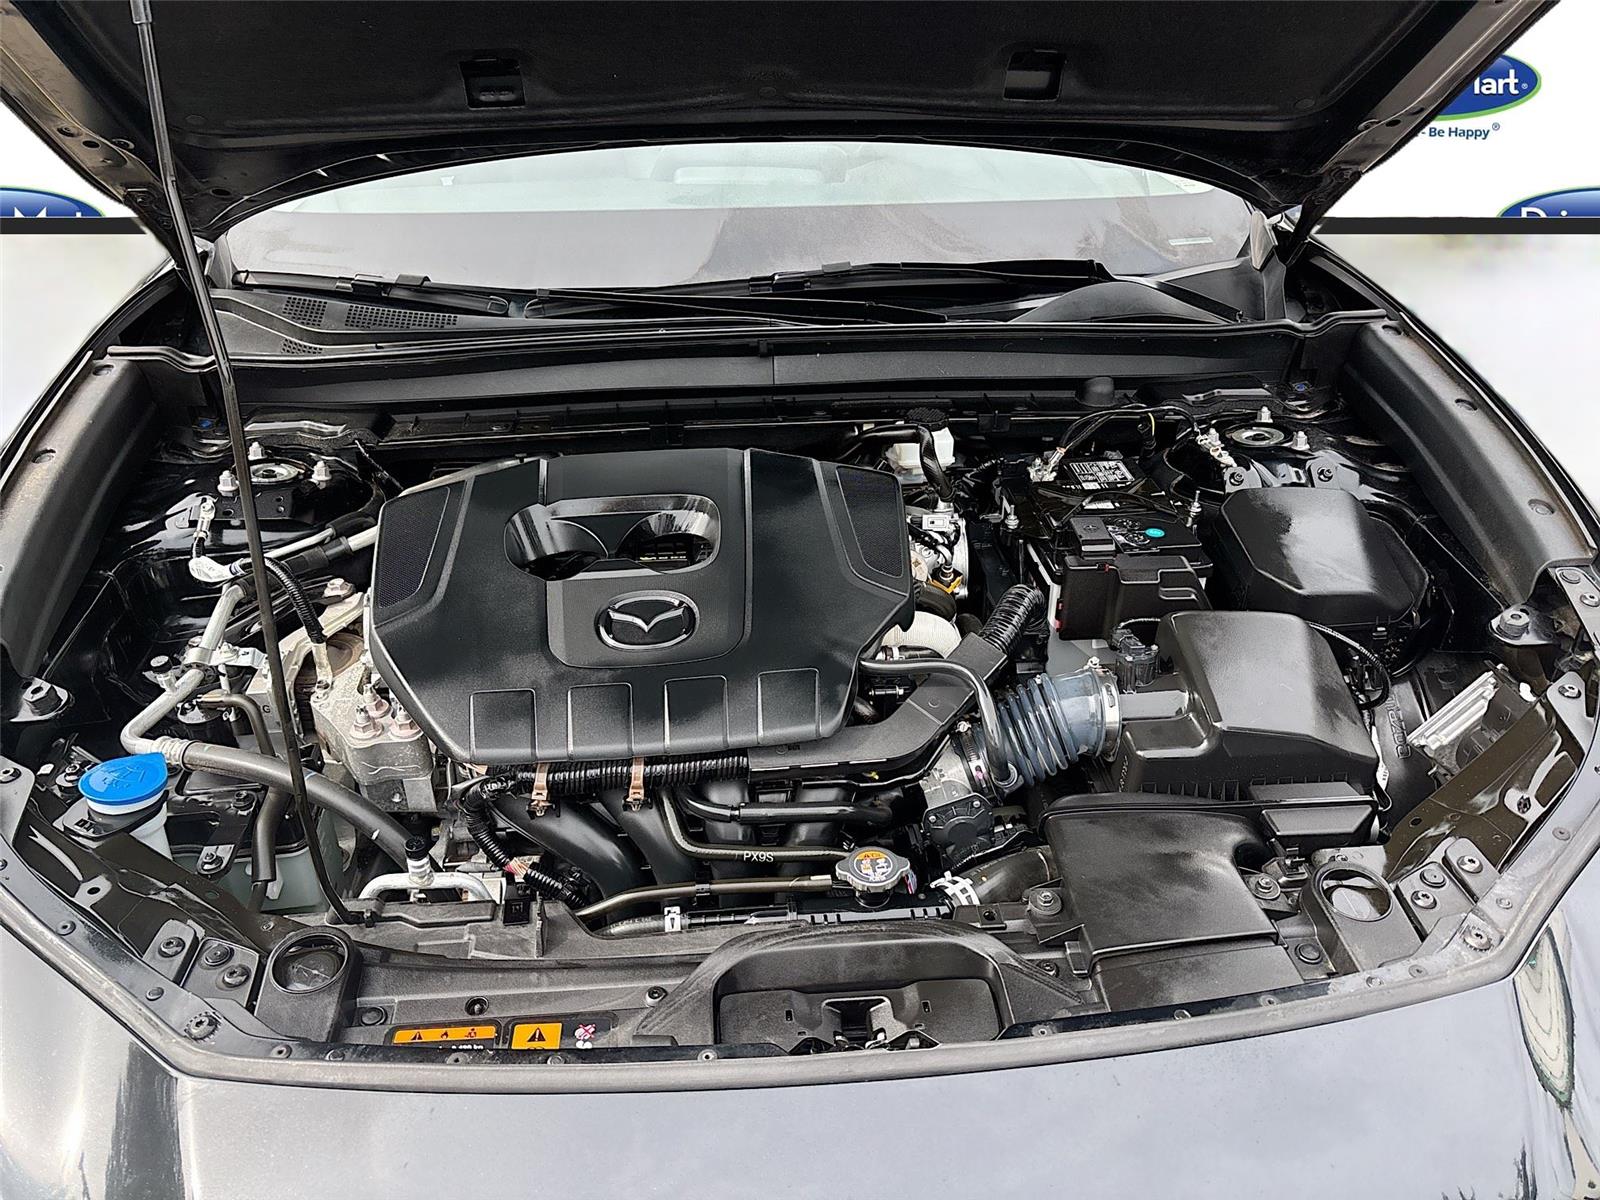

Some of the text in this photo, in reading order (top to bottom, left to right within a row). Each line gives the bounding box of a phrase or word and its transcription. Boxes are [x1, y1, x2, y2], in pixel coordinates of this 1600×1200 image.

[1428, 127, 1445, 137] Be
[1448, 127, 1490, 140] Happy
[743, 851, 774, 863] PX9S
